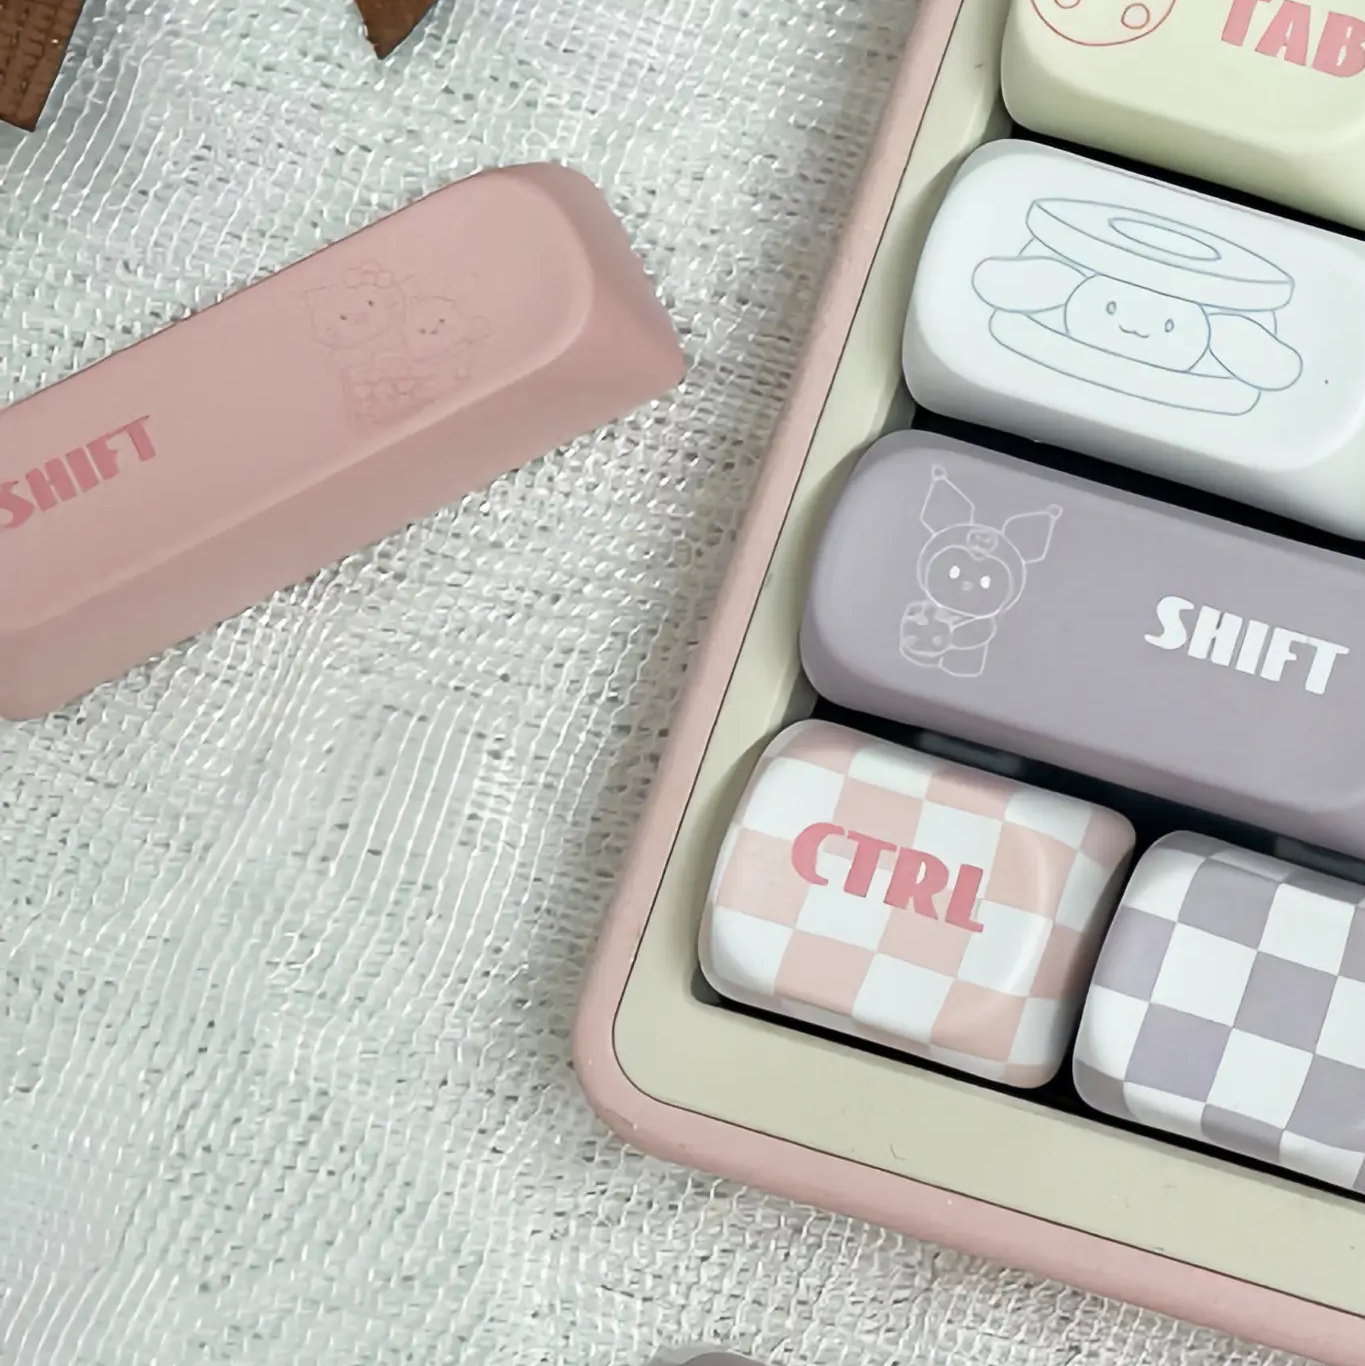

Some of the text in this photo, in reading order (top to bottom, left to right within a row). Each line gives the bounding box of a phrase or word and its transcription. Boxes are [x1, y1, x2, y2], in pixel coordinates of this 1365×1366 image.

[0, 414, 157, 529] SHIFT
[1144, 596, 1350, 695] SHIFT
[790, 821, 985, 934] CTRL
